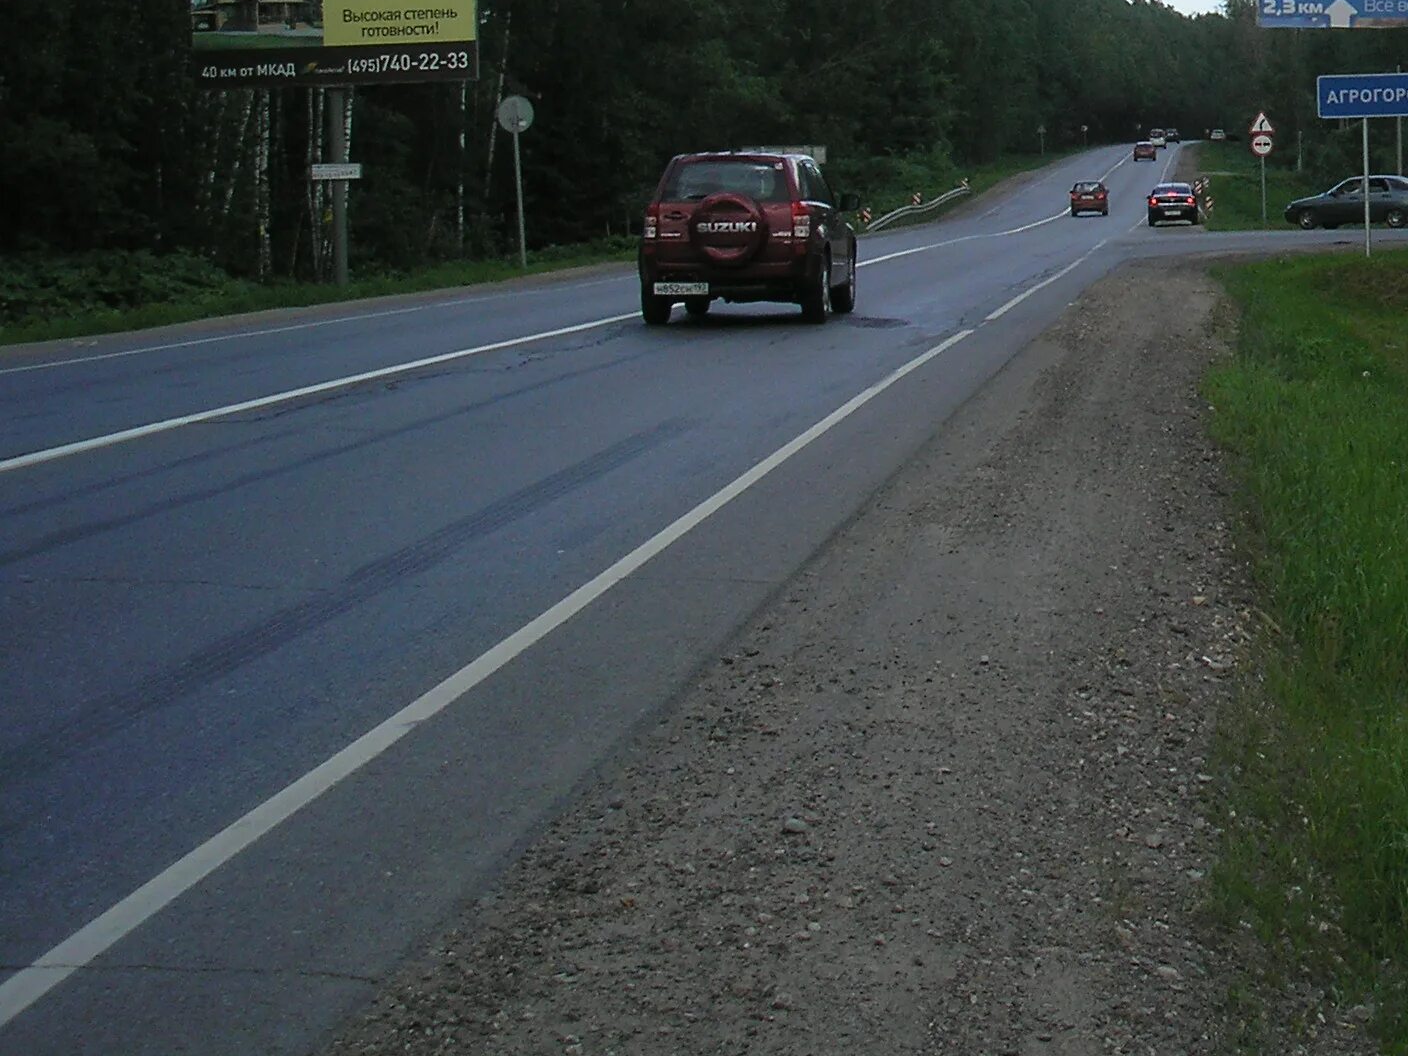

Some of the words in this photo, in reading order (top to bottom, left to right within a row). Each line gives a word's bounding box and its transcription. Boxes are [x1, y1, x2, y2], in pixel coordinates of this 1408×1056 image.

[343, 9, 401, 23] Высокая
[404, 8, 458, 21] степень
[1263, 0, 1296, 16] 2,3
[361, 21, 440, 38] готовности!
[201, 66, 217, 79] 40
[220, 68, 238, 78] км
[240, 67, 254, 77] от
[257, 63, 296, 78] МКАД
[696, 222, 757, 233] SUZUKI
